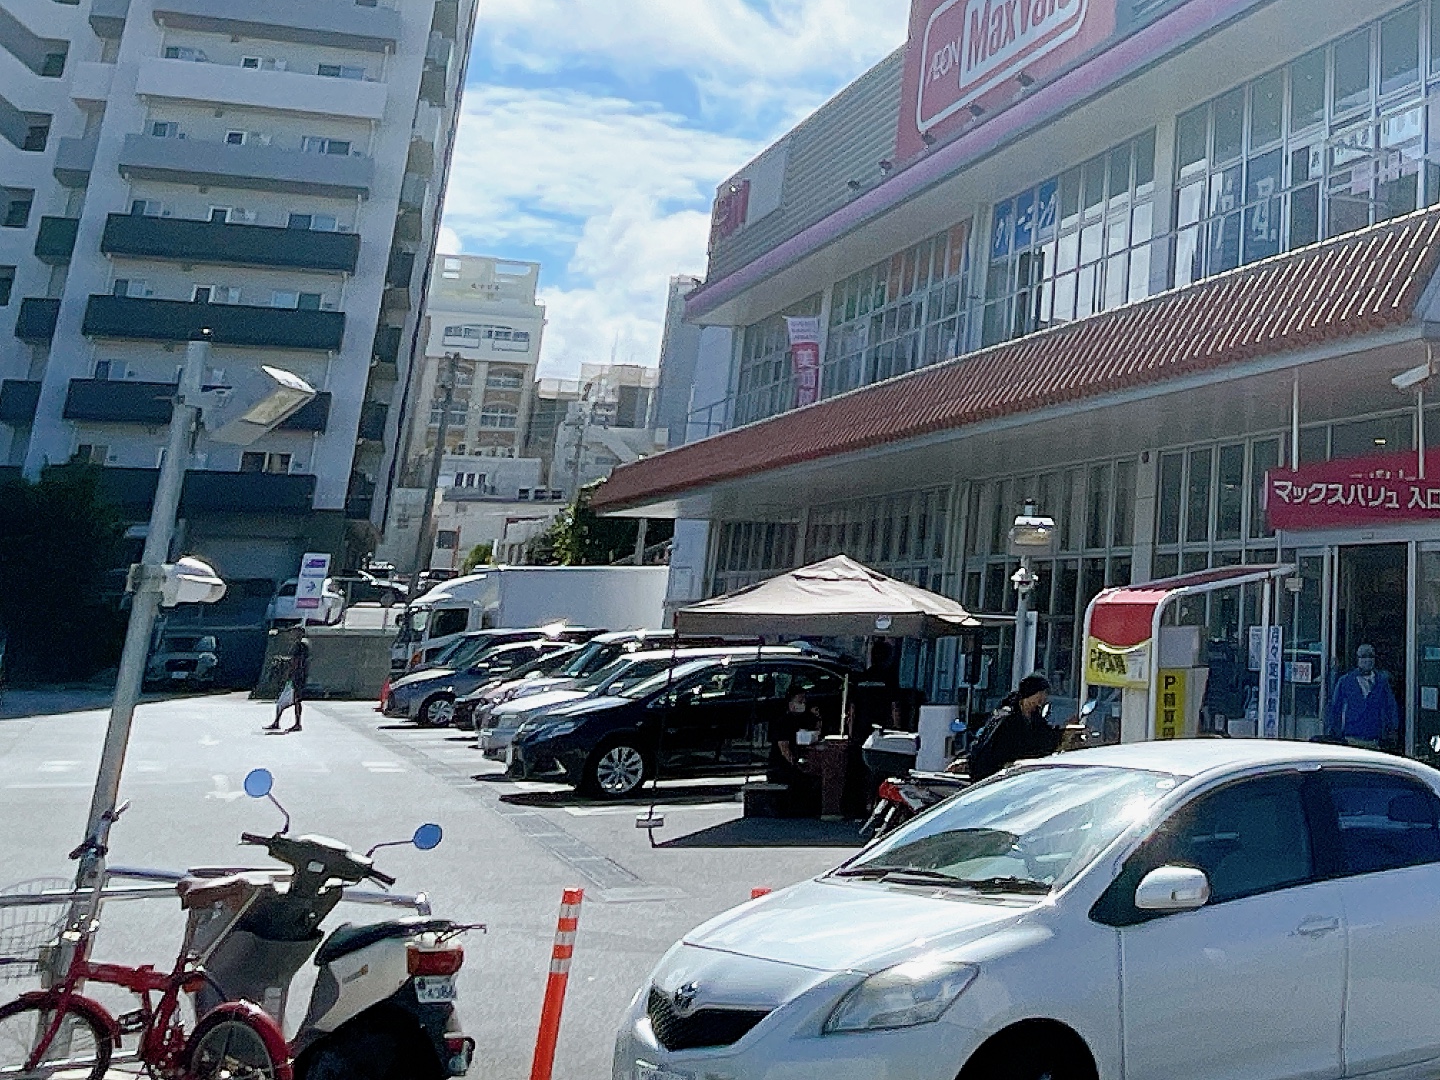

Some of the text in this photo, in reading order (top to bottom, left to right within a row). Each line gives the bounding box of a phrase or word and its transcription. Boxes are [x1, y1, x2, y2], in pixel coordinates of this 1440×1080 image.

[926, 31, 962, 86] AEON
[1273, 480, 1400, 509] マックスバリュ
